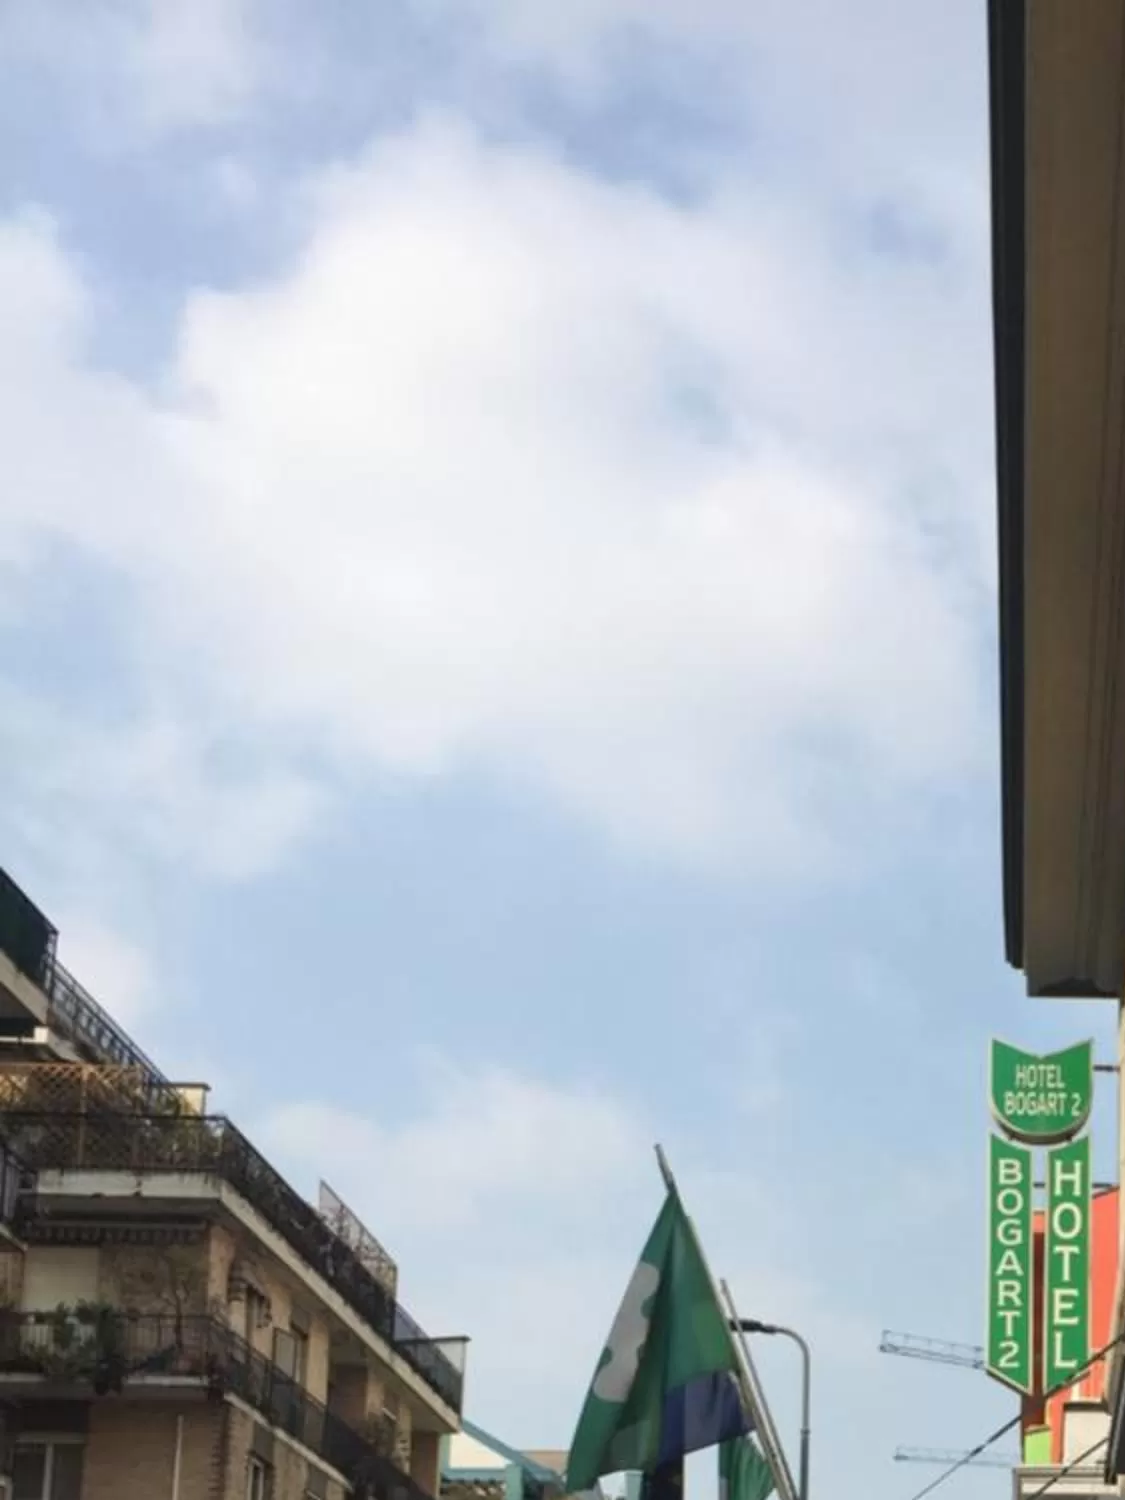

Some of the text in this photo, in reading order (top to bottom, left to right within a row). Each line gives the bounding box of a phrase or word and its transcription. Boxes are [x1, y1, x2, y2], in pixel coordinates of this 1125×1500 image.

[1015, 1064, 1066, 1089] HOTEL
[1004, 1092, 1081, 1117] BOGART 2
[1052, 1160, 1082, 1368] HOTEL
